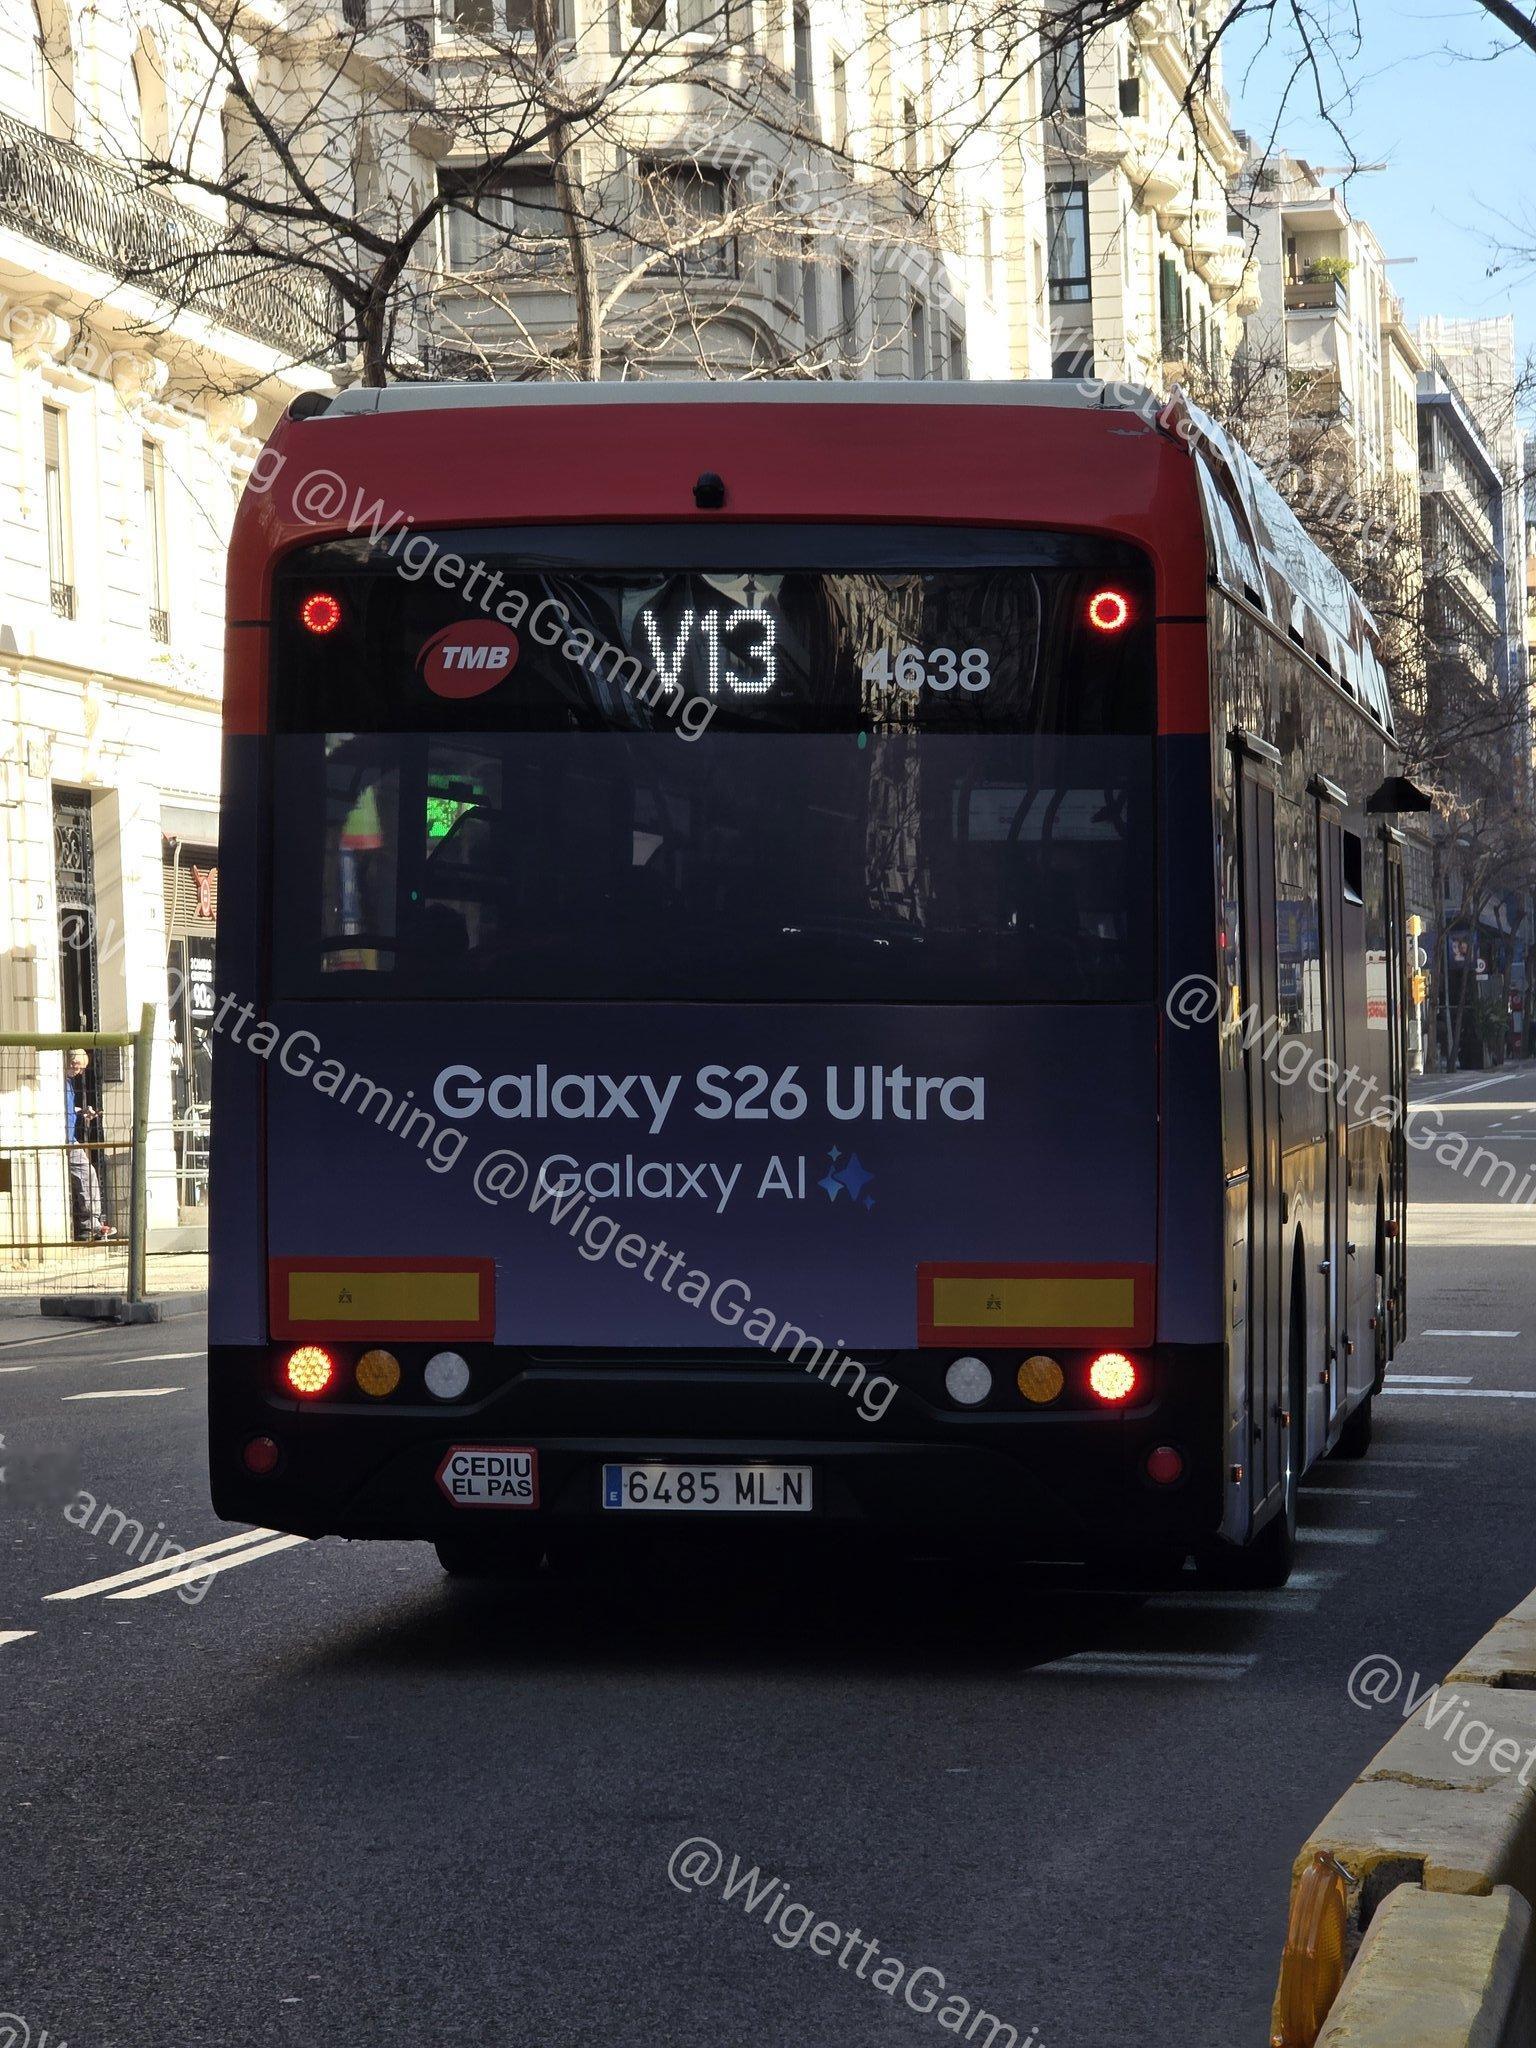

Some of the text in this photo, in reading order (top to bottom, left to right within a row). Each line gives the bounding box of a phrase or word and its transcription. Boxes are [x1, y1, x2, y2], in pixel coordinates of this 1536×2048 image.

[441, 645, 510, 670] TMB
[643, 608, 776, 695] V13
[861, 647, 991, 692] 4638
[433, 1064, 986, 1134] Galaxy S26 Ultra
[538, 1153, 806, 1213] Galaxy AI
[451, 1456, 532, 1478] CEDIU
[452, 1478, 533, 1498] EL PAS
[610, 1470, 804, 1506] E 6485 MLN
